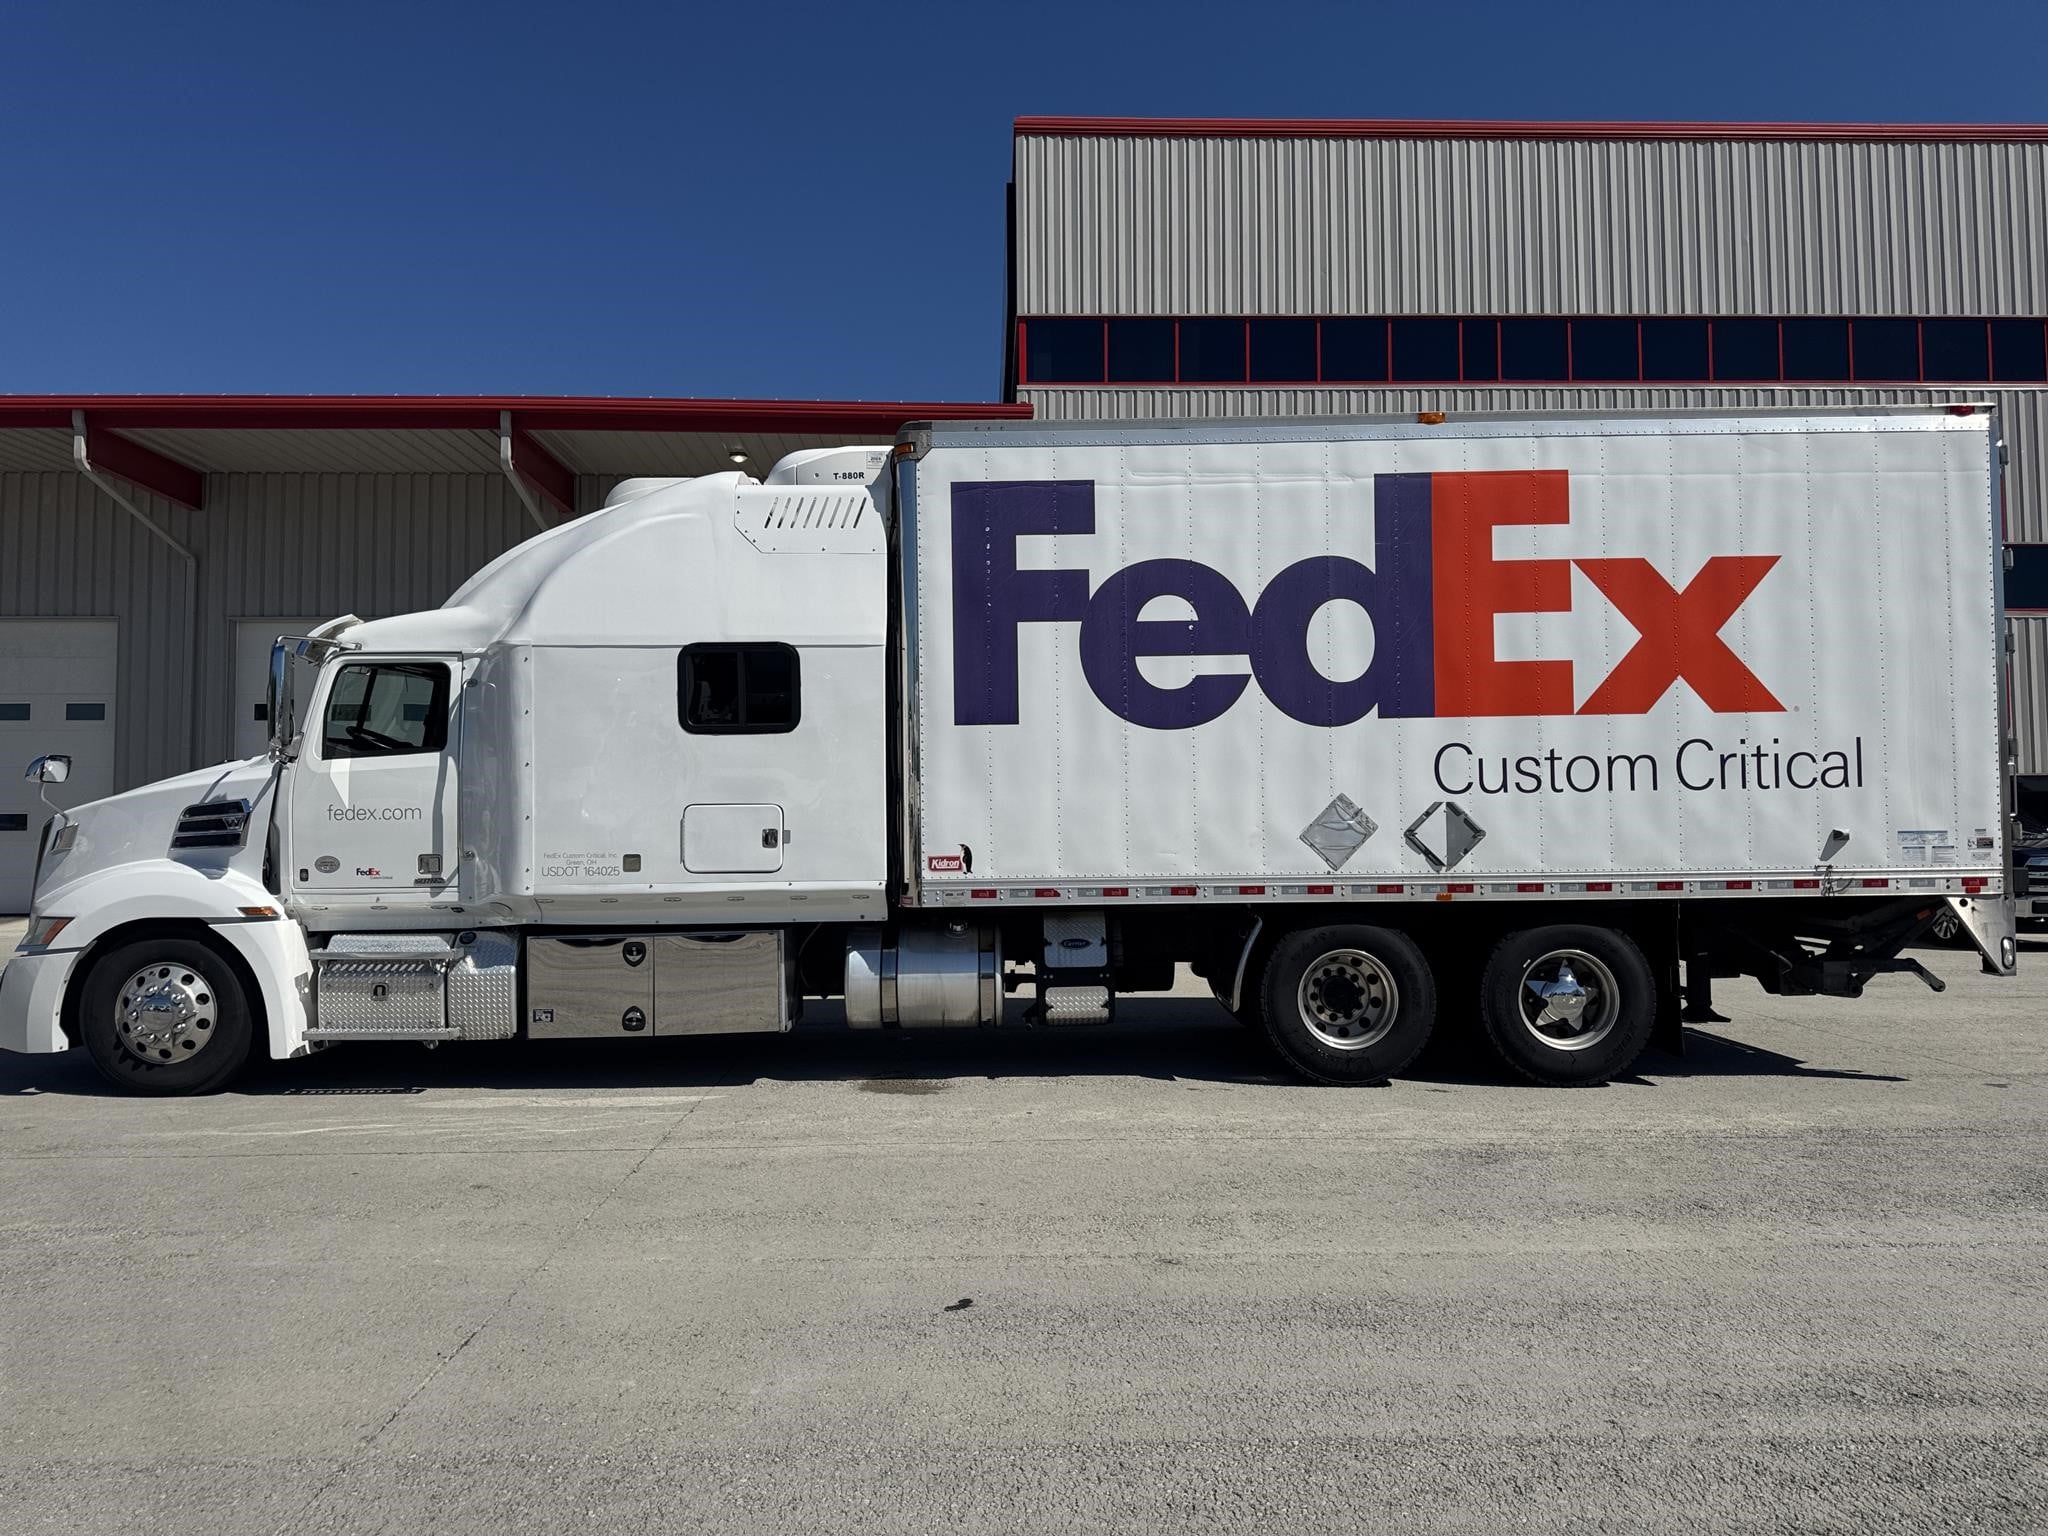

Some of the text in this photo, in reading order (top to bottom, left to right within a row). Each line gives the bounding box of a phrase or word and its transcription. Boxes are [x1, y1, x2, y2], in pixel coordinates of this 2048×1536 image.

[832, 471, 865, 480] T-880R
[951, 469, 1787, 730] FedEx
[1434, 736, 1864, 796] Custom Critical
[327, 804, 422, 821] fedex.com
[931, 858, 960, 869] Kidron
[356, 867, 380, 876] FedEx
[541, 866, 620, 877] USDOT 164025
